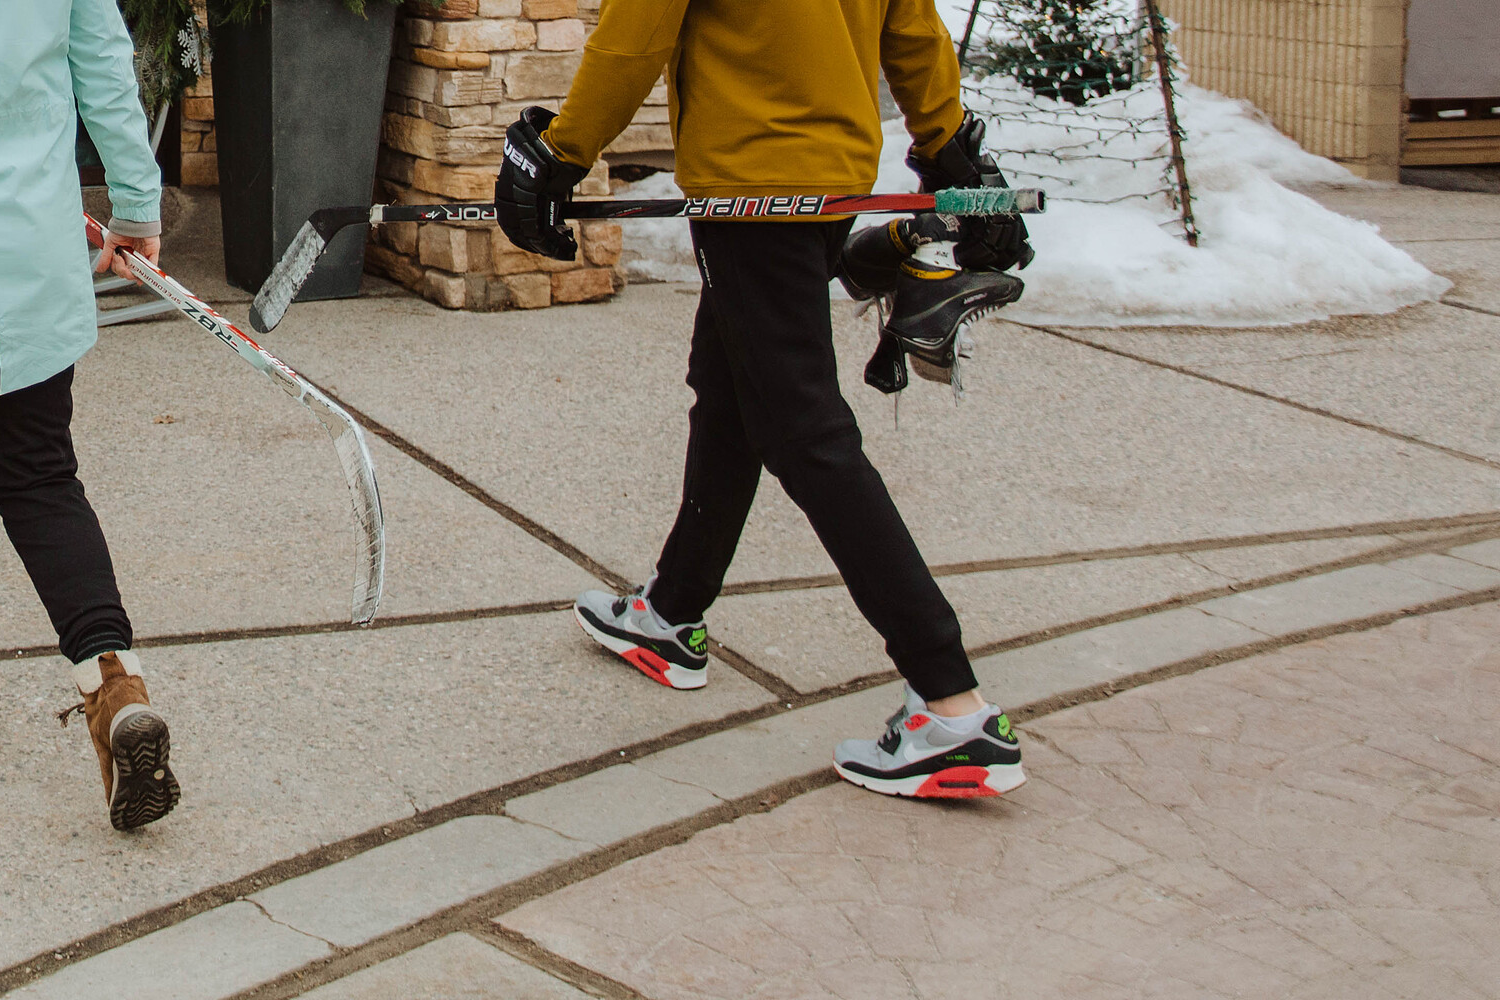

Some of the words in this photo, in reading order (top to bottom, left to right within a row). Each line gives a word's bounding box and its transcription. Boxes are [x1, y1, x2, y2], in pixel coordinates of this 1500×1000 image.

[503, 136, 537, 179] UER
[440, 204, 498, 221] POR
[682, 195, 826, 217] BAUER
[129, 263, 182, 305] SPEEDBURNER
[182, 301, 240, 353] RBZ
